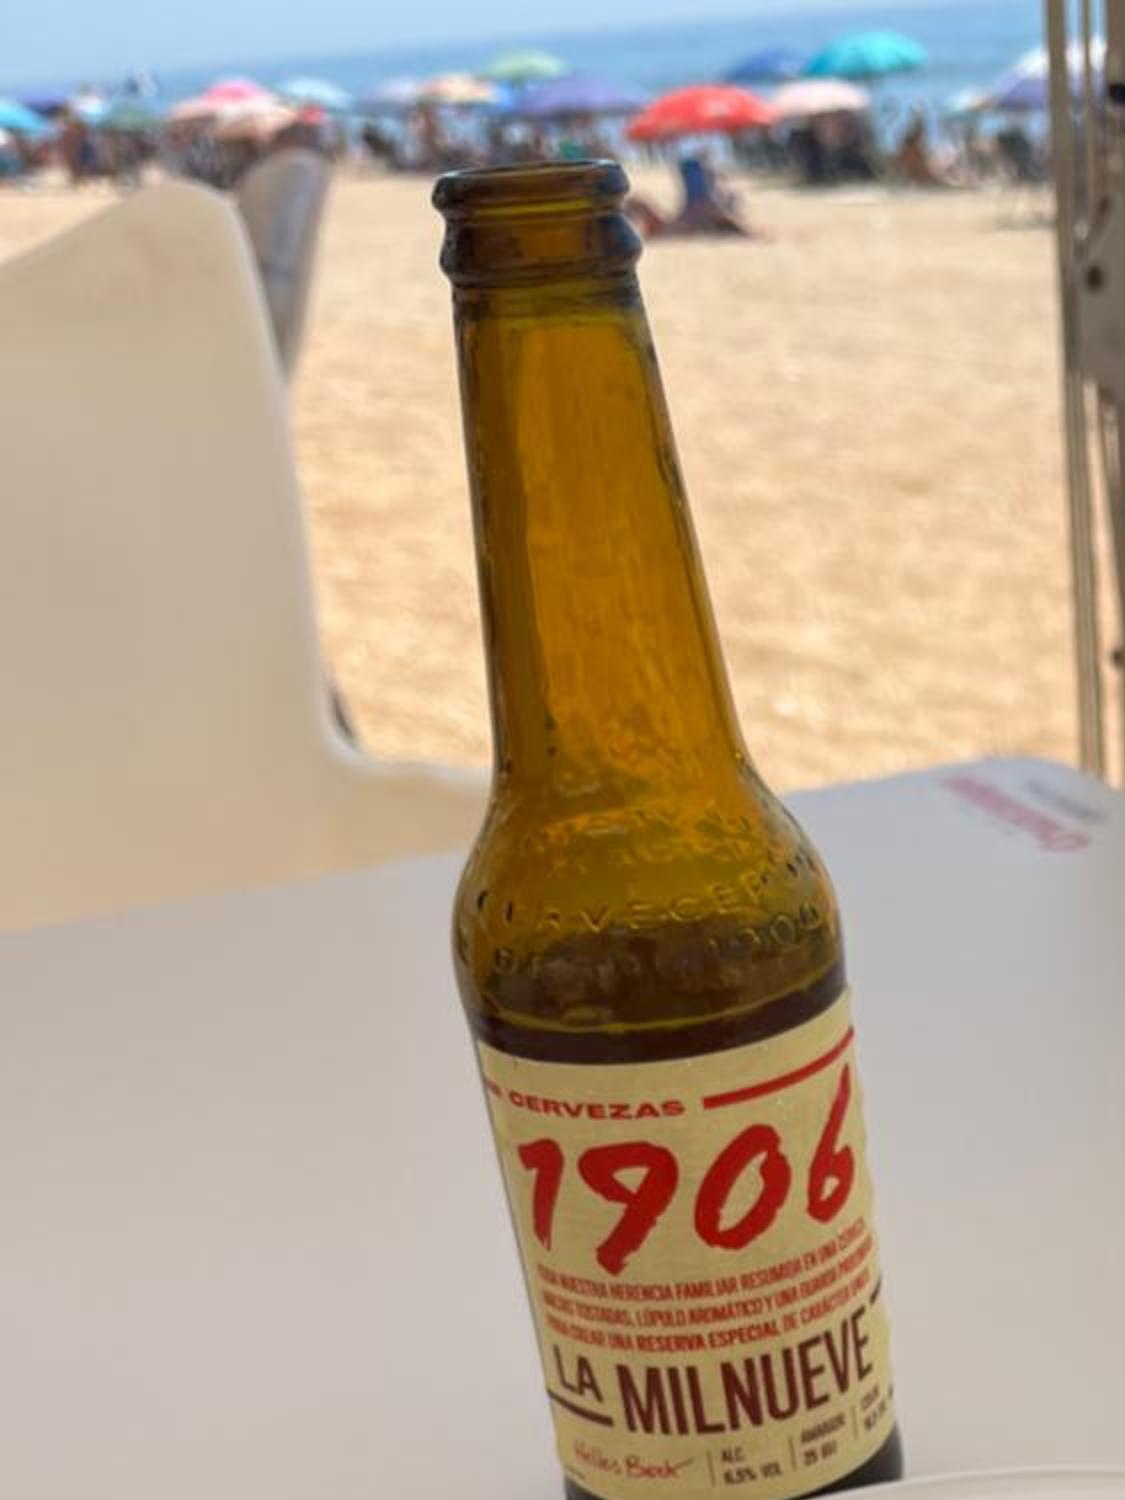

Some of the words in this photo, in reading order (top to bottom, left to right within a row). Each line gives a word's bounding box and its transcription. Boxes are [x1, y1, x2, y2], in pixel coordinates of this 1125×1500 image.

[510, 1091, 686, 1119] CERVEZAS
[517, 1063, 855, 1276] 1906
[553, 1344, 604, 1403] LA
[616, 1306, 873, 1435] MILNUEVE
[636, 1334, 705, 1352] RESERVA
[708, 1320, 780, 1348] ESPECIAL
